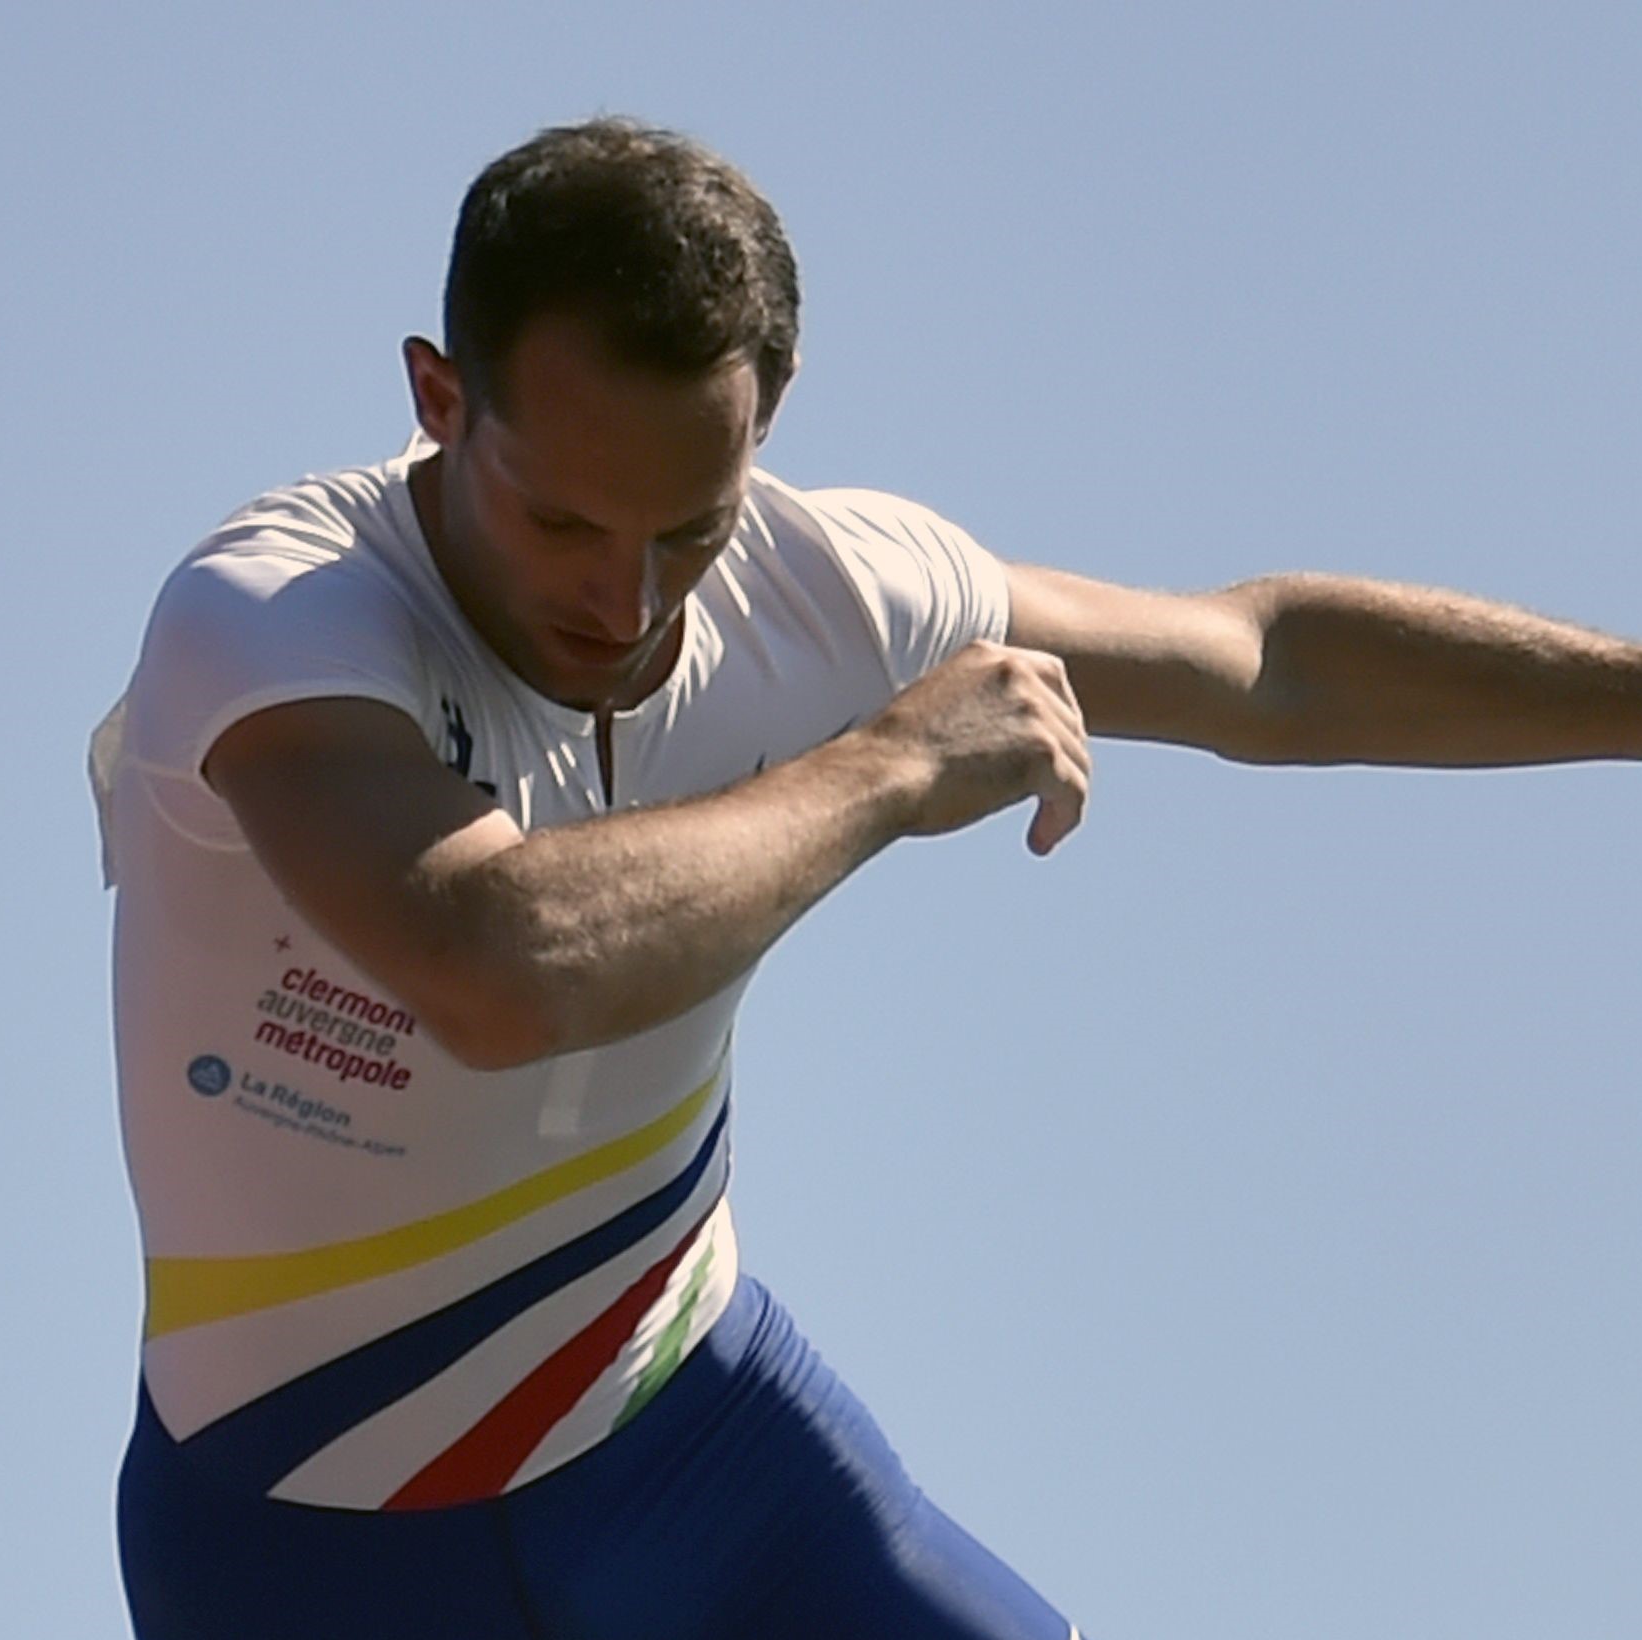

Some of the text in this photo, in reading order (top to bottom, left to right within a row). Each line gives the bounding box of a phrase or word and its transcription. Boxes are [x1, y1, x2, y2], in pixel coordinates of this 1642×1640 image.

[255, 1021, 412, 1090] métropole
[257, 989, 396, 1056] auvergne
[240, 1072, 351, 1127] La Région
